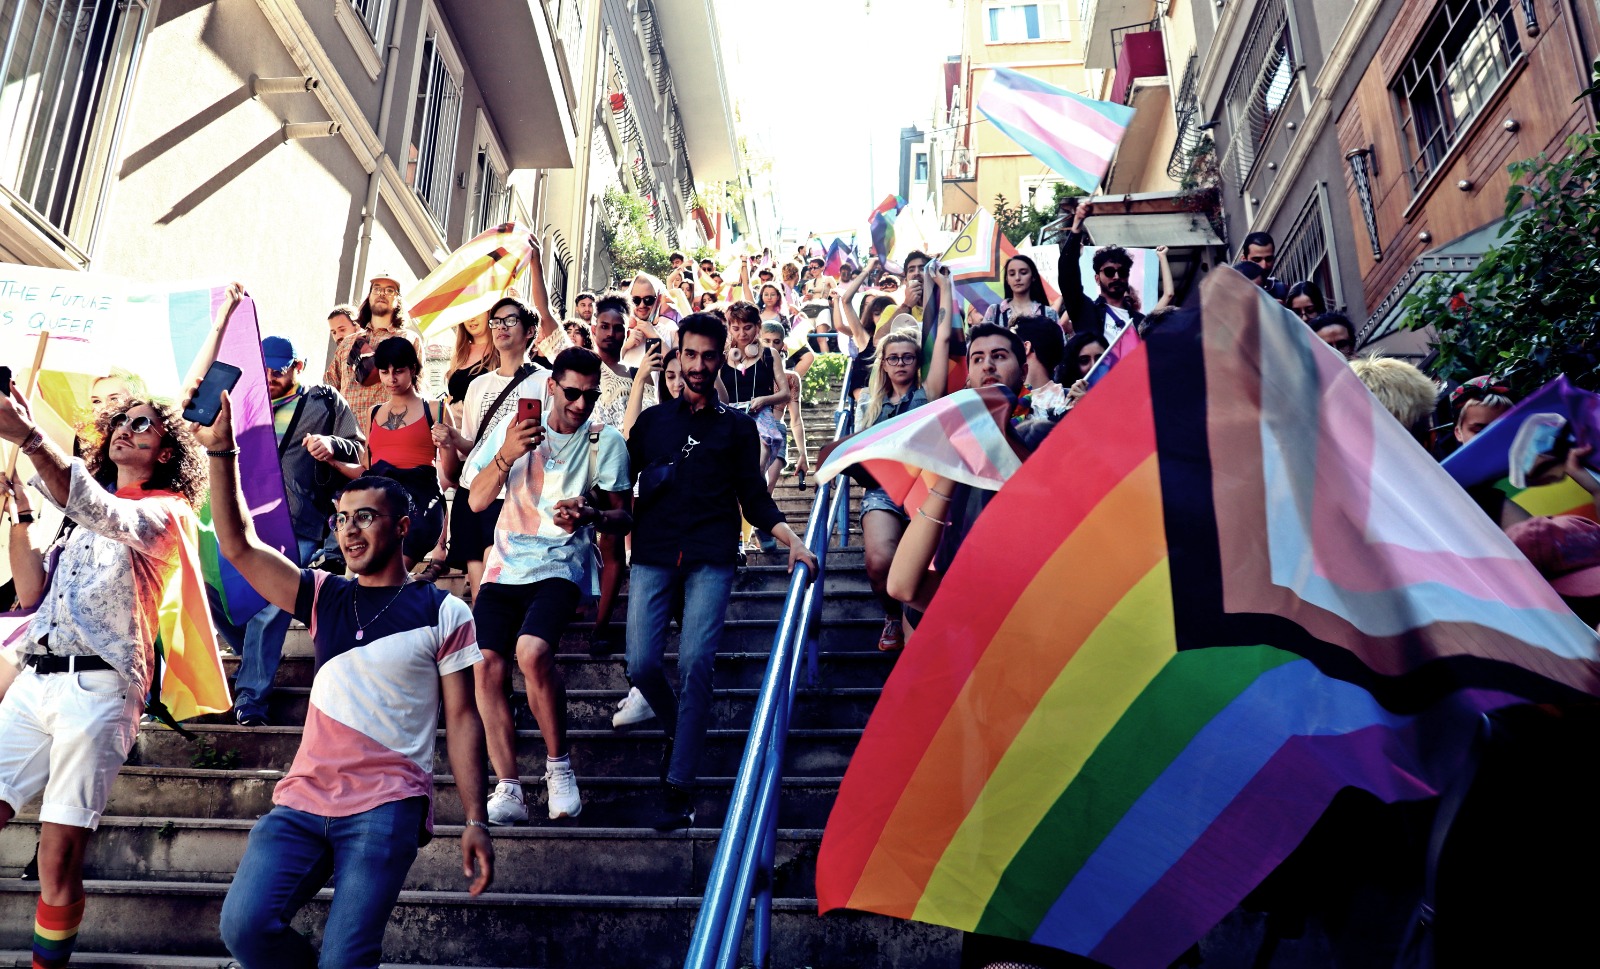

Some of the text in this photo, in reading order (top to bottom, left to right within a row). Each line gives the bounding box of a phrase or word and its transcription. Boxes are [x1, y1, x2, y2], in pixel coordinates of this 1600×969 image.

[0, 280, 40, 301] THE
[0, 310, 95, 334] S QUEER
